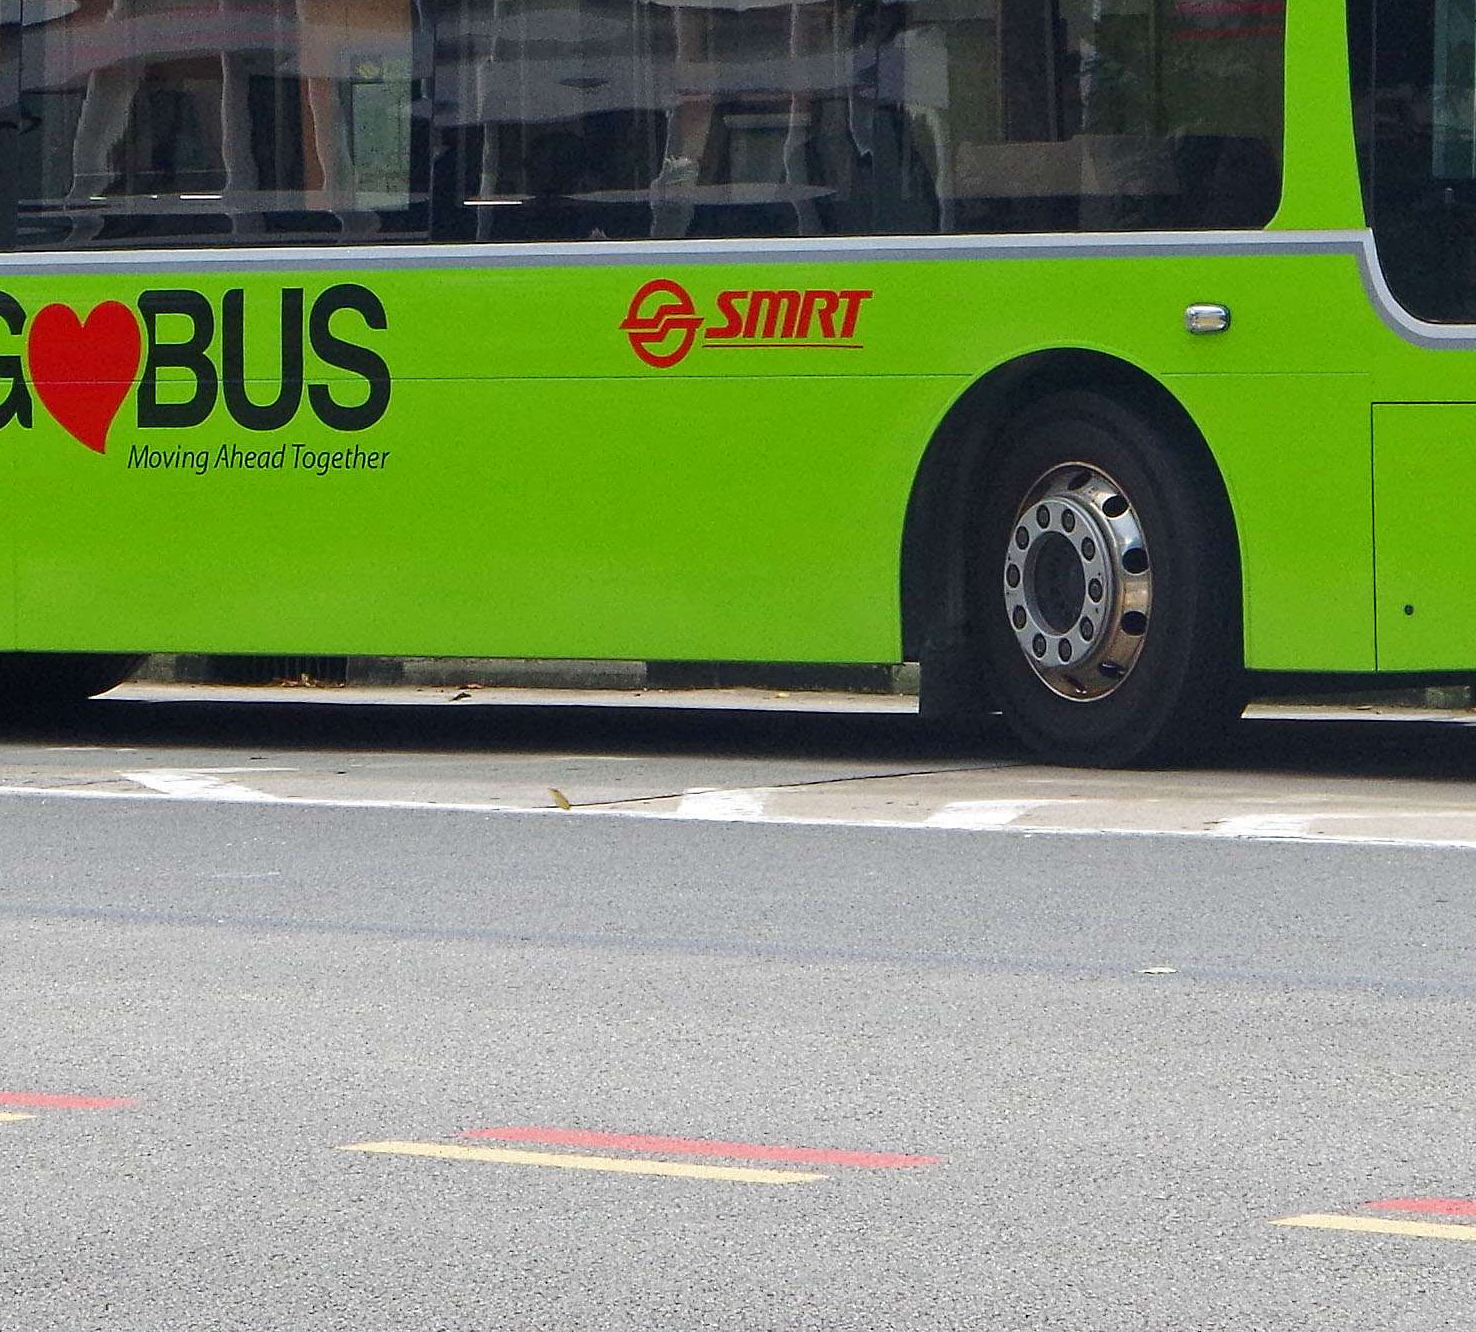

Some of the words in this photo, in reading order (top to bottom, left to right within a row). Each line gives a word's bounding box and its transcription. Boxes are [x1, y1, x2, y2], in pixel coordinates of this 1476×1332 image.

[704, 290, 873, 339] SMRT
[128, 444, 210, 476] Moving
[214, 443, 285, 470] Ahead
[291, 443, 391, 476] Together
